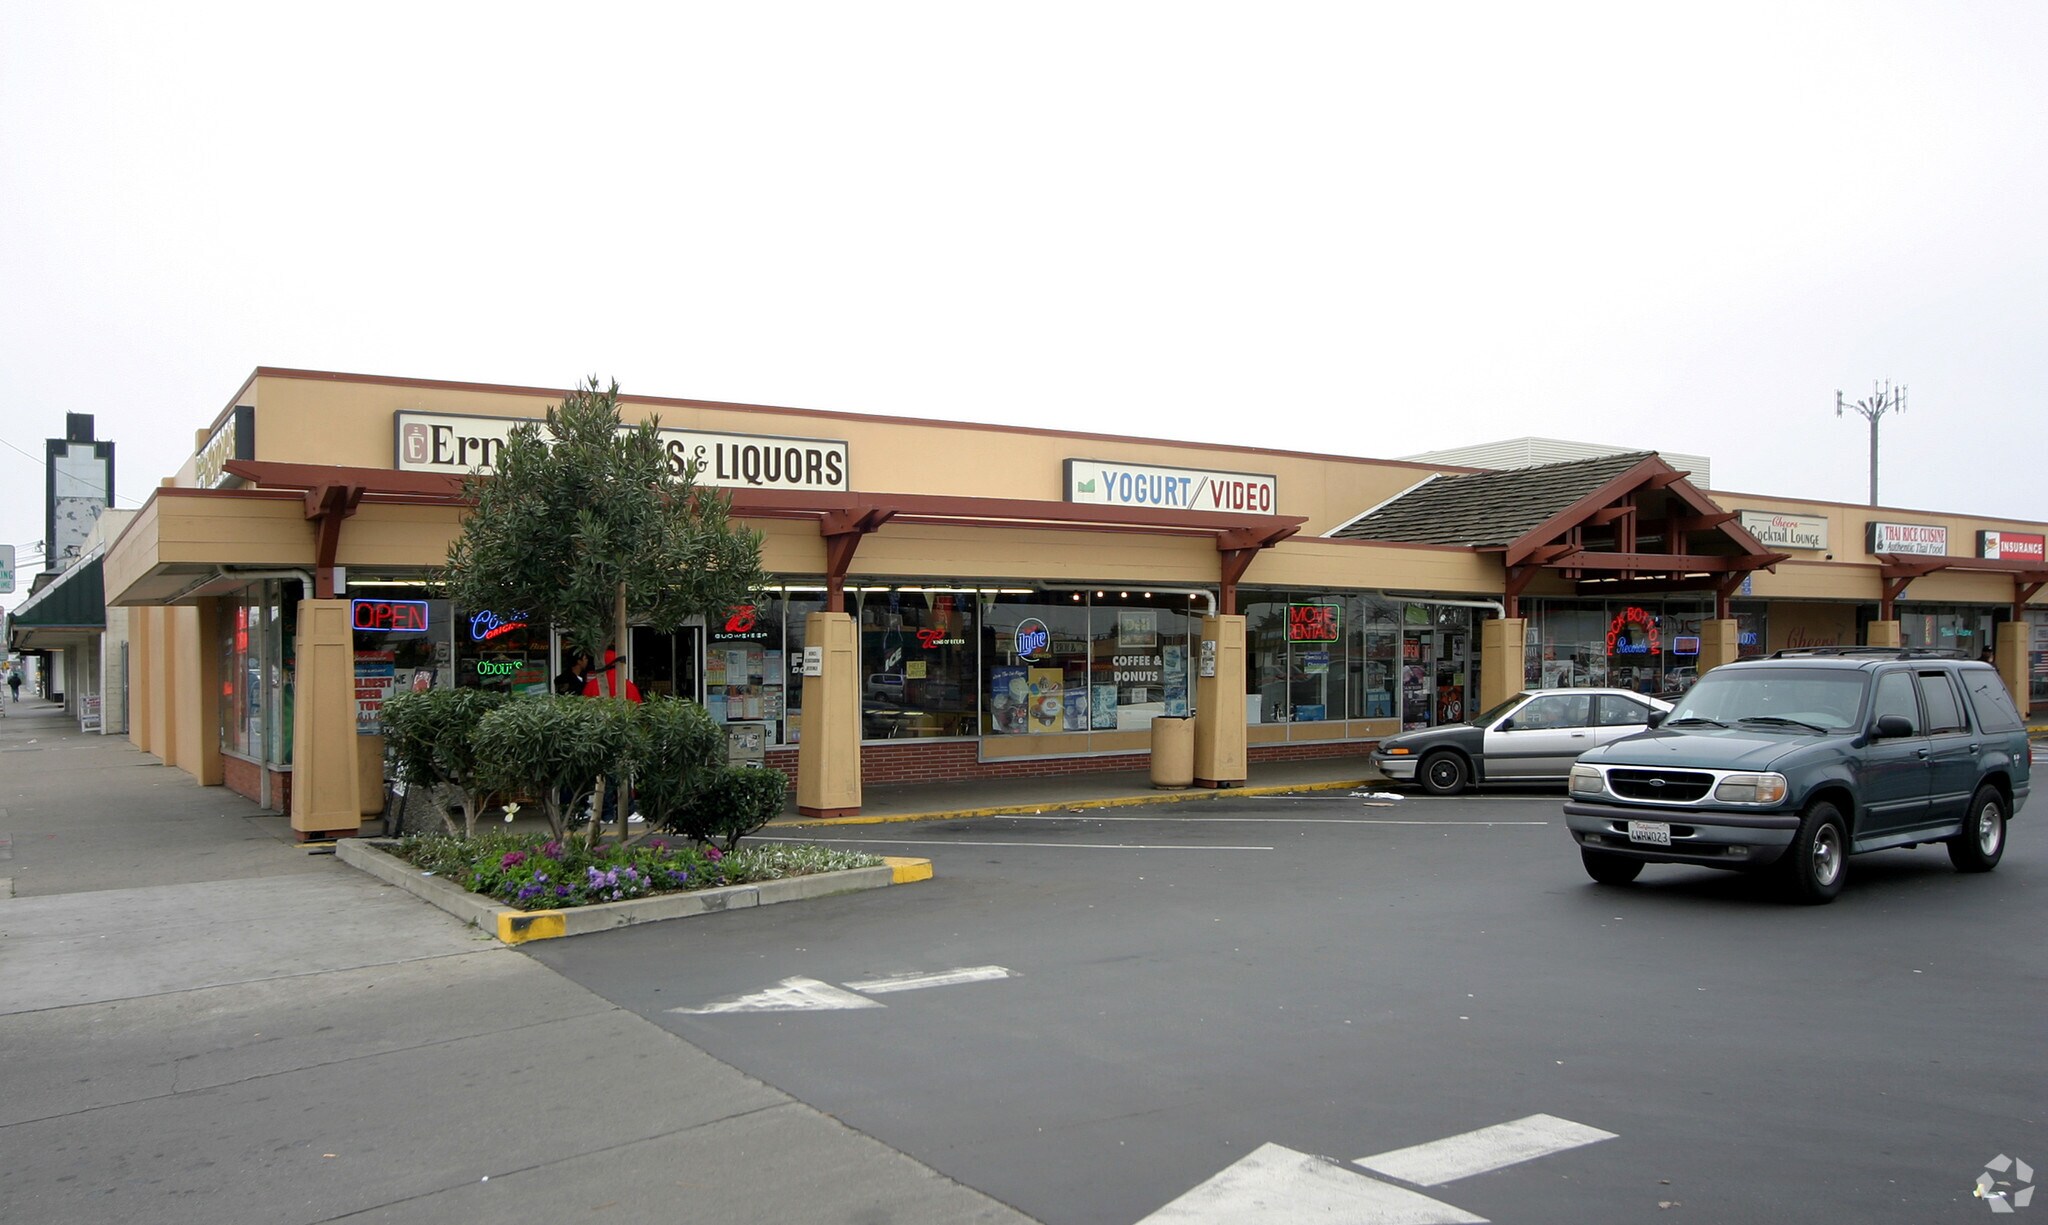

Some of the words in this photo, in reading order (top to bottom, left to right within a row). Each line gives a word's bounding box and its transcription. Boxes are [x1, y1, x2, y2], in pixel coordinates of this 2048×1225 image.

[428, 424, 505, 467] Ern
[694, 445, 709, 473] &
[716, 443, 843, 485] LIQUORS
[1102, 471, 1191, 506] YOGURT
[1210, 479, 1271, 512] VIDEO
[1772, 516, 1799, 528] Cheers
[1885, 526, 1901, 541] THAI
[1903, 527, 1918, 542] RICE
[1920, 528, 1945, 543] CUISINE
[1886, 542, 1915, 553] Authentic
[1916, 543, 1928, 553] Thai
[1929, 544, 1944, 554] Food
[2001, 541, 2043, 554] INSURANCE
[355, 603, 425, 629] OPEN
[1289, 623, 1337, 639] RENTALS
[884, 647, 902, 671] ICE
[1112, 655, 1149, 666] COFFEE
[1153, 655, 1162, 666] &
[1114, 671, 1158, 682] DONUTS
